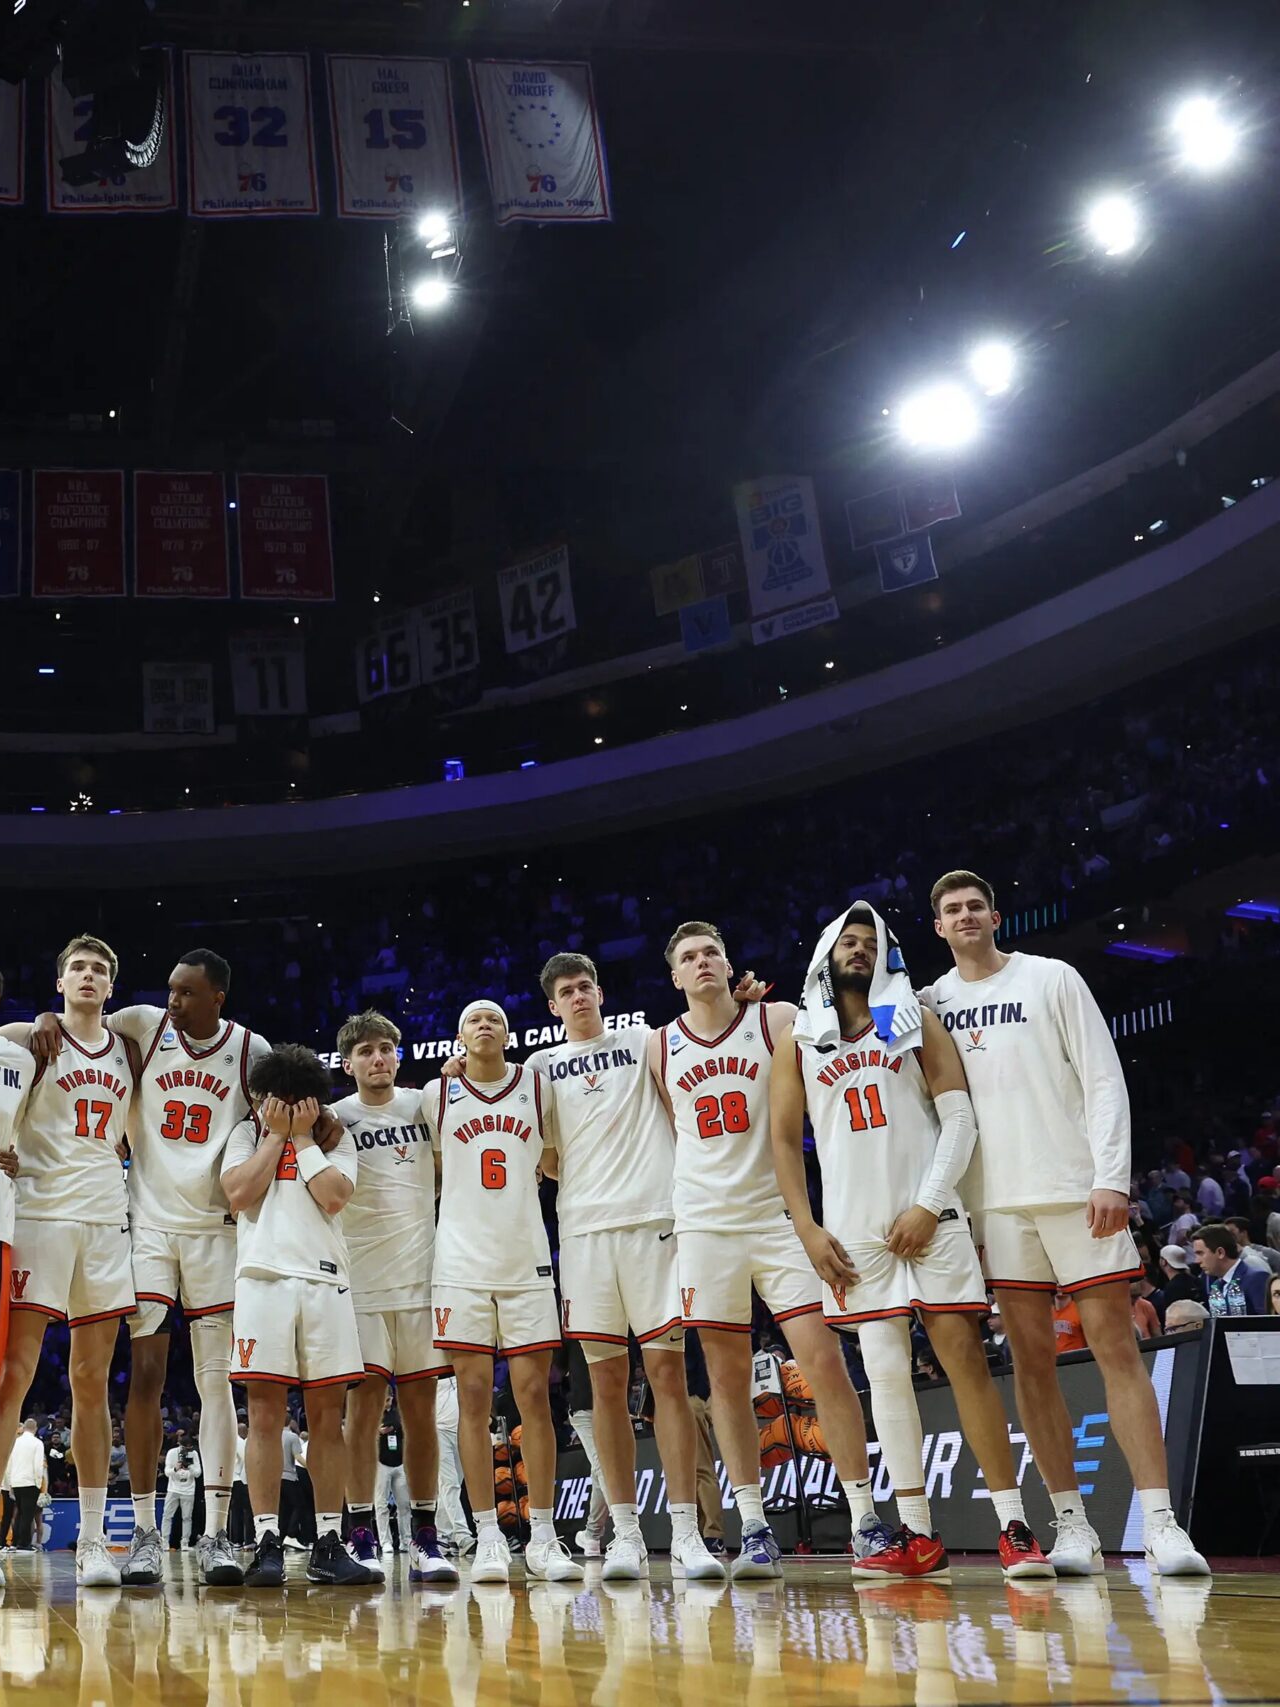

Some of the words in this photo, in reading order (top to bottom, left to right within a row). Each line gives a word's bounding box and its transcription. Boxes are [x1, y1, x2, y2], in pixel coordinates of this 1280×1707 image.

[372, 81, 409, 94] GREER
[378, 68, 400, 80] HAL
[507, 85, 555, 97] ZINKOFF
[513, 72, 546, 84] DAVID
[214, 106, 288, 147] 32
[364, 109, 427, 149] 15
[238, 173, 266, 192] 76
[385, 175, 413, 193] 76
[527, 174, 556, 193] 76
[511, 571, 565, 640] 42
[430, 609, 472, 677] 35
[248, 657, 288, 710] 11
[982, 1005, 999, 1026] IT
[1001, 1002, 1028, 1024] IN.
[412, 1029, 518, 1060] VIRGA
[3, 1068, 22, 1090] IN.
[549, 1053, 589, 1082] LOCK
[592, 1050, 609, 1070] IT
[611, 1048, 637, 1067] IN.
[676, 1056, 759, 1093] VIRGINIA
[816, 1049, 902, 1087] VIRGINIA
[56, 1068, 127, 1100] VIRGINIA
[155, 1070, 230, 1101] VIRGINIA
[74, 1098, 113, 1140] 17
[160, 1100, 212, 1143] 33
[694, 1091, 751, 1139] 28
[844, 1084, 888, 1132] 11
[353, 1126, 396, 1151] LOCK
[400, 1123, 418, 1140] IT
[453, 1114, 533, 1144] VIRGINIA
[275, 1140, 298, 1181] 2
[481, 1148, 507, 1189] 6
[555, 1476, 593, 1520] THE
[760, 1455, 840, 1508] INAL
